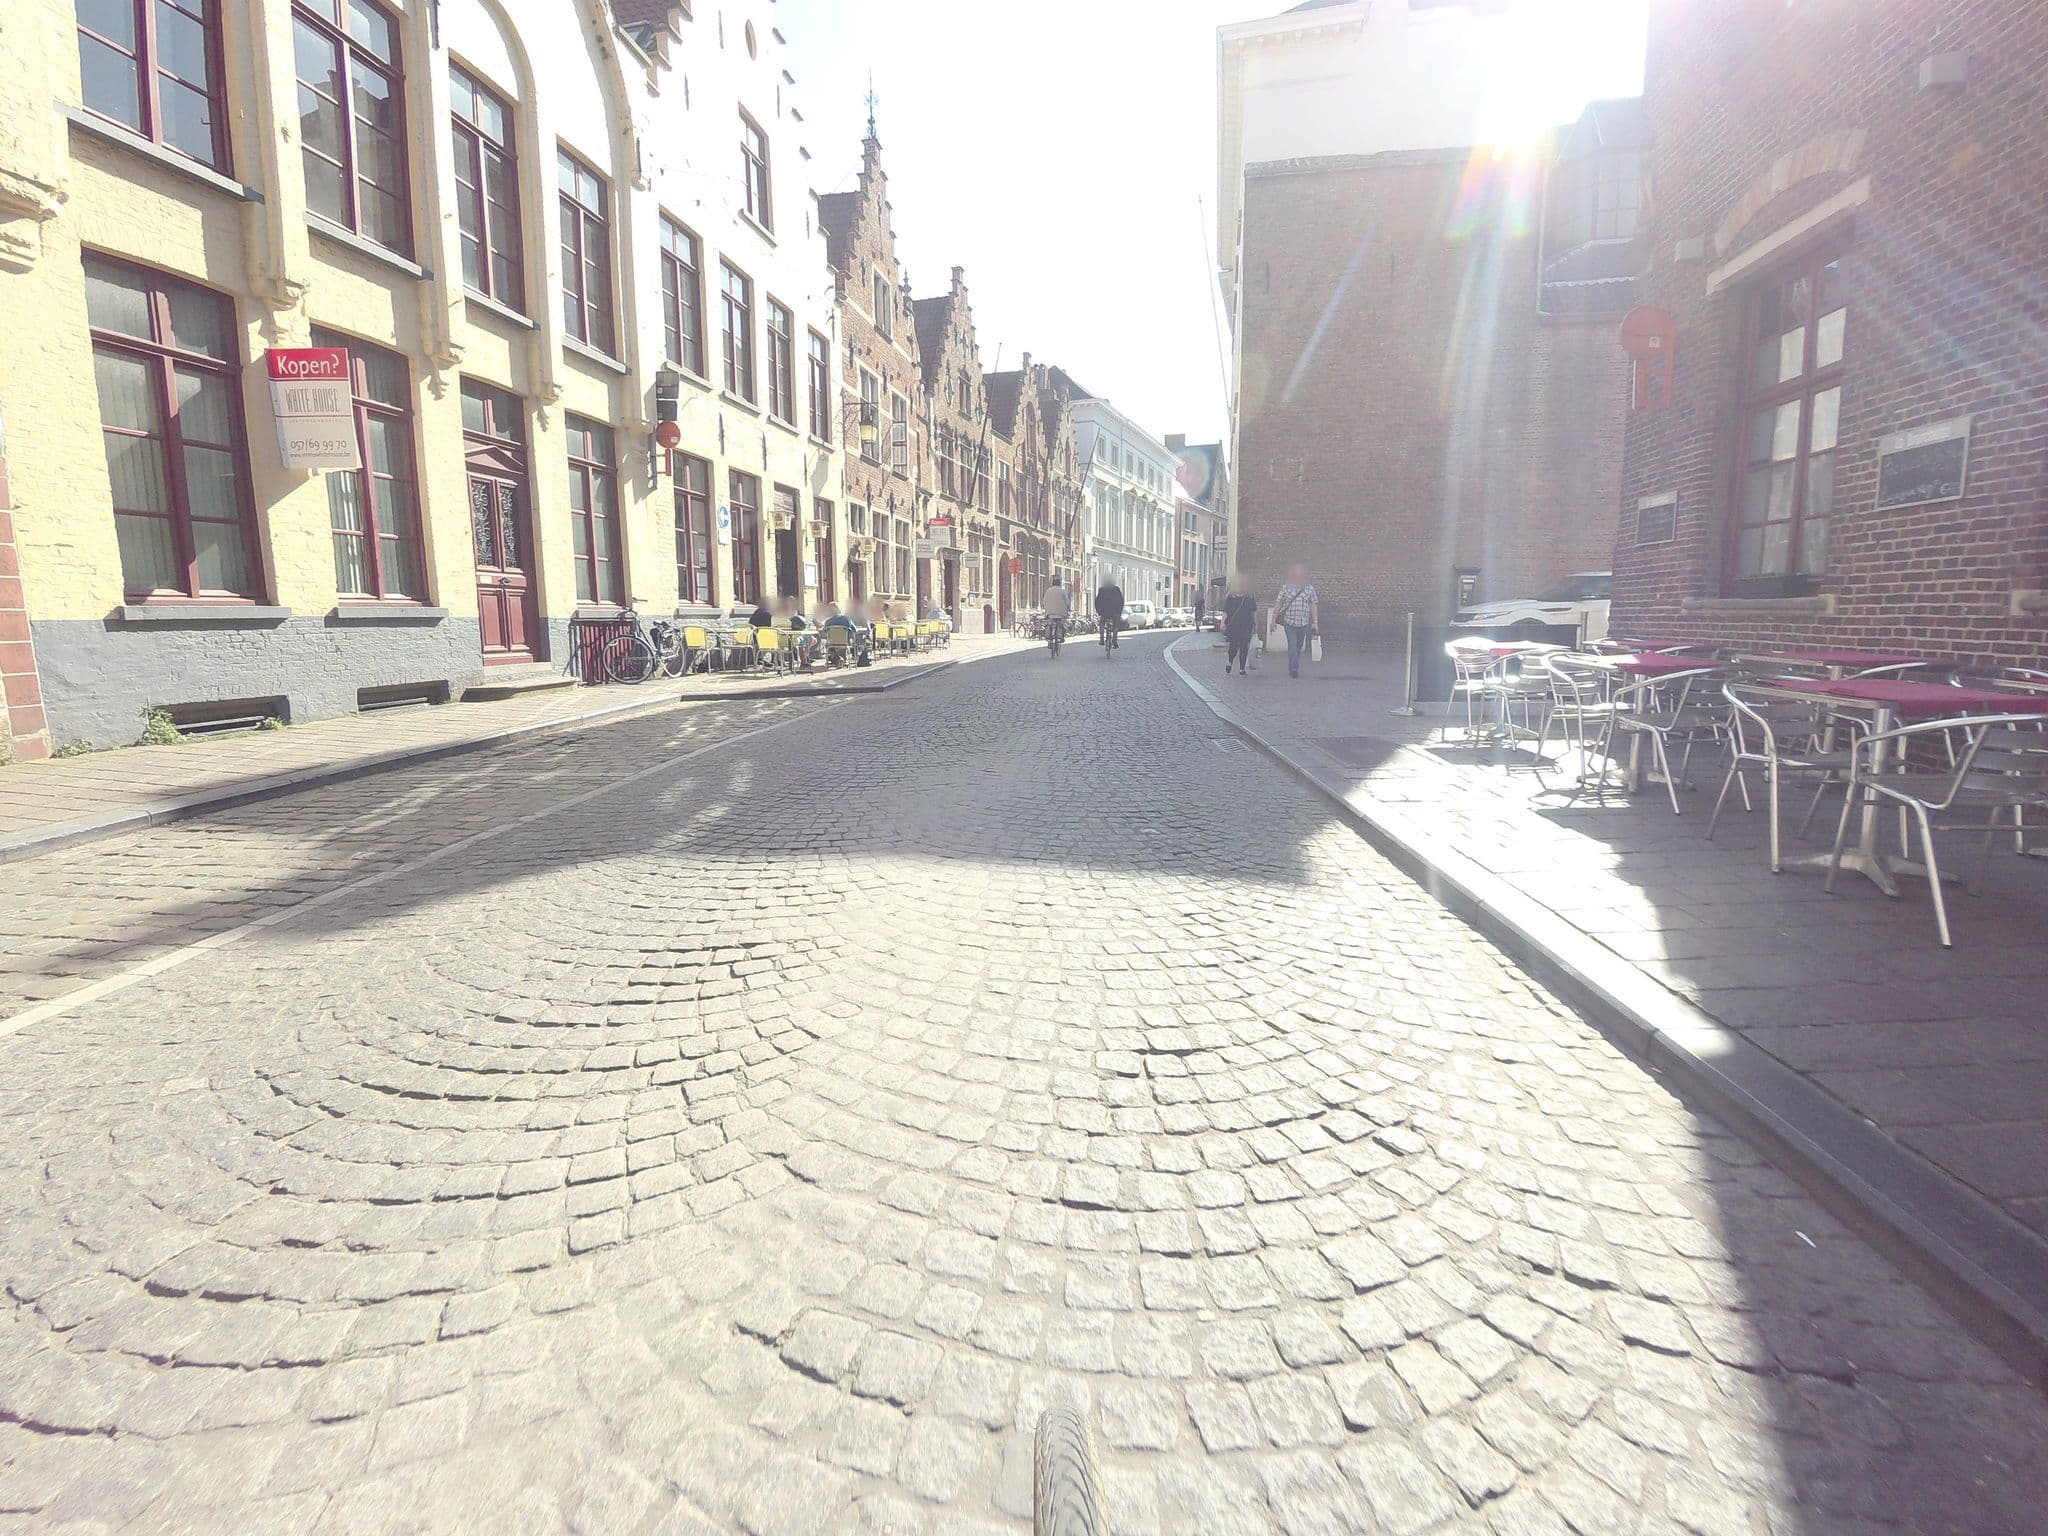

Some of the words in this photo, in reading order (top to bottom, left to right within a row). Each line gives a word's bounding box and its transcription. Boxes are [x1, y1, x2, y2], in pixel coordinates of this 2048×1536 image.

[277, 353, 340, 380] Kopen?
[285, 388, 310, 413] WHITE
[312, 388, 340, 413] HOUSE
[290, 438, 320, 451] 057/69
[322, 440, 334, 451] 99
[335, 440, 348, 451] 70
